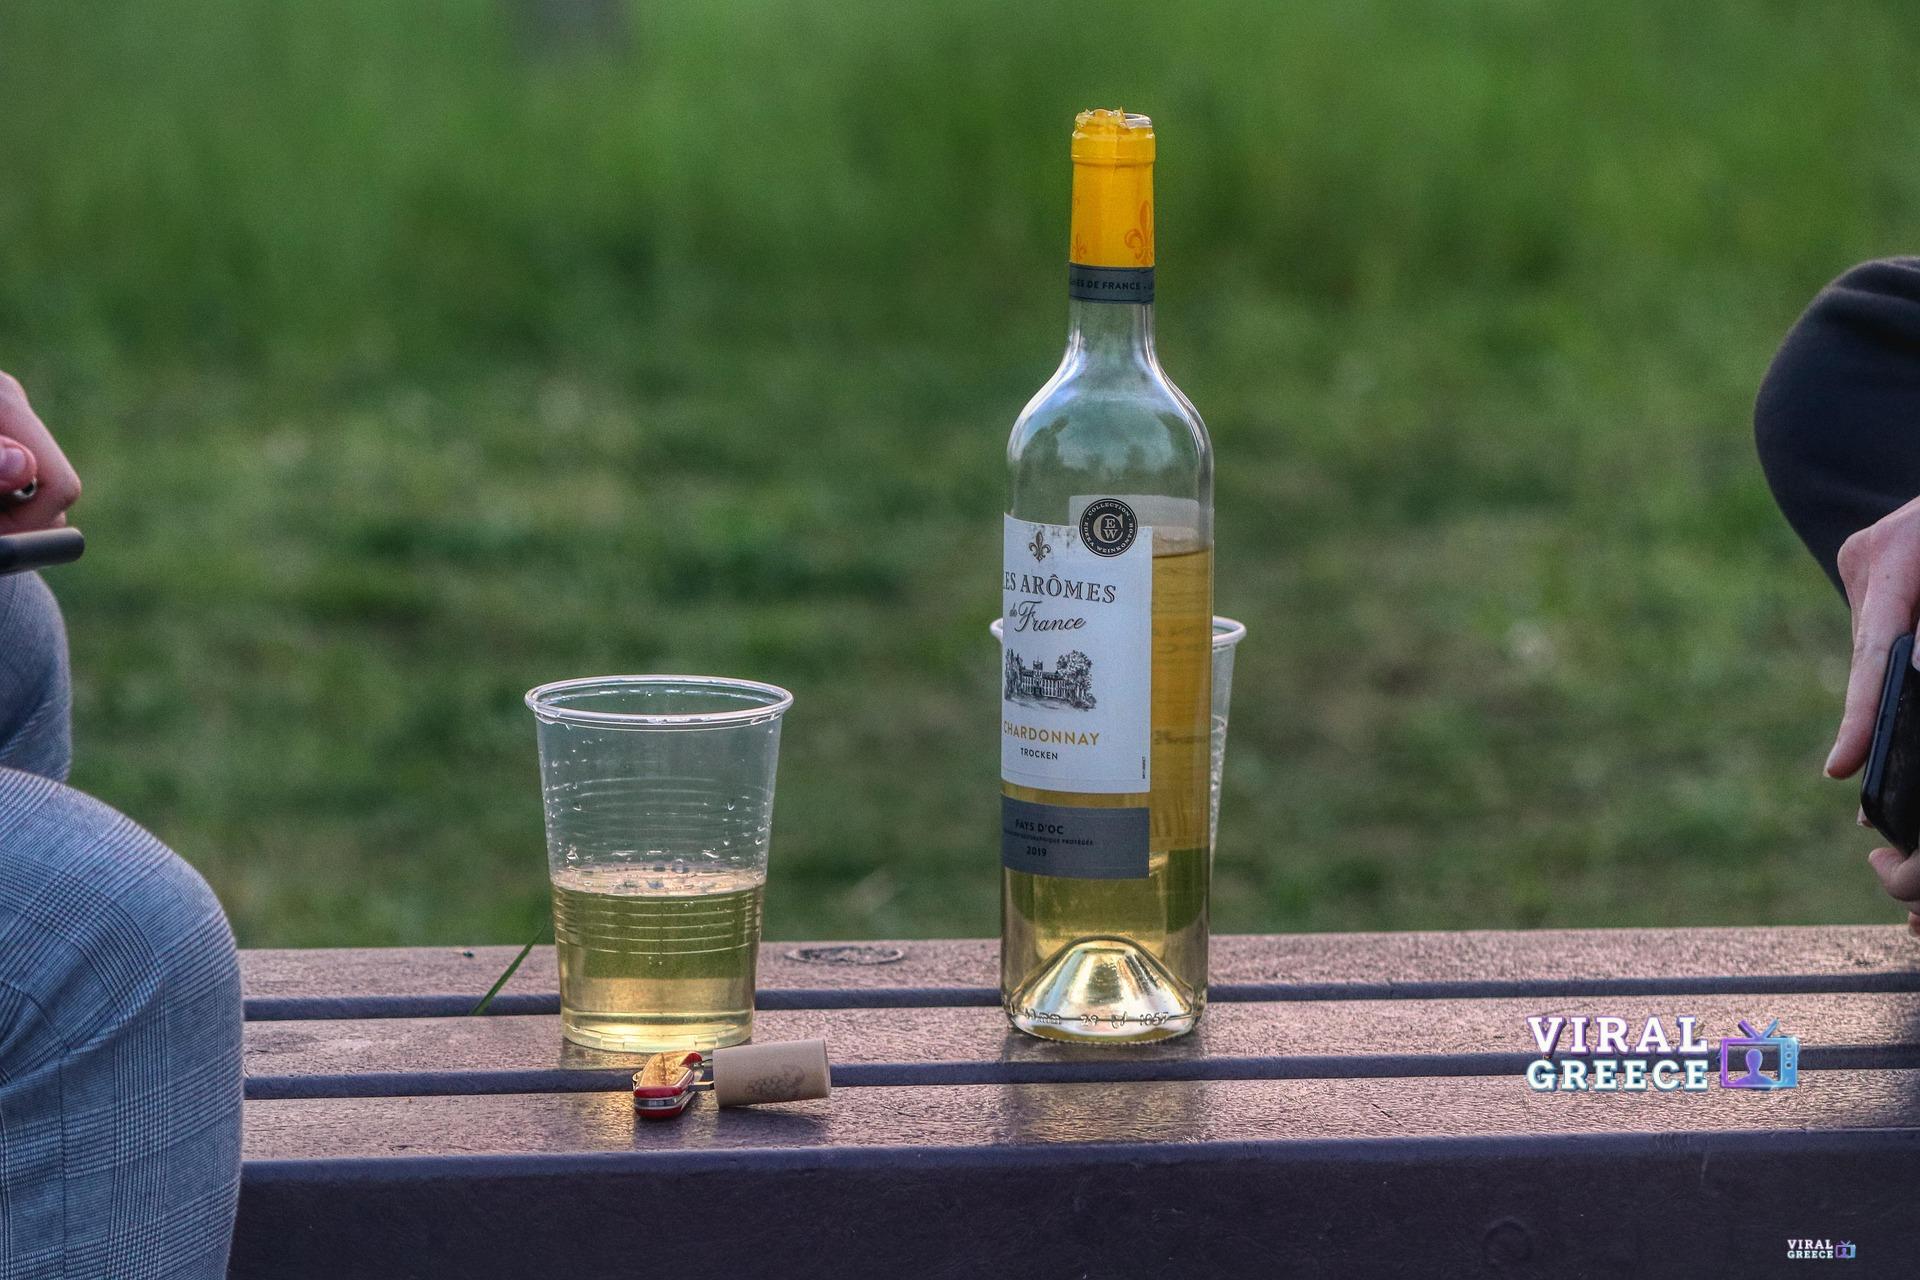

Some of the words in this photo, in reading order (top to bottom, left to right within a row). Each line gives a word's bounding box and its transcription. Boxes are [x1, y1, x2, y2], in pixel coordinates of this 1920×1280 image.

[1087, 281, 1099, 289] DE
[1102, 281, 1141, 290] FRANCE
[1088, 502, 1131, 517] COLLECTION
[1020, 574, 1116, 604] ARÔMES
[1014, 599, 1087, 633] France
[1003, 720, 1100, 746] CHARDONNAY
[1020, 747, 1058, 761] TROCKEN
[1015, 819, 1035, 832] PAYS
[1038, 823, 1065, 835] D'OC
[1026, 846, 1047, 857] 2019
